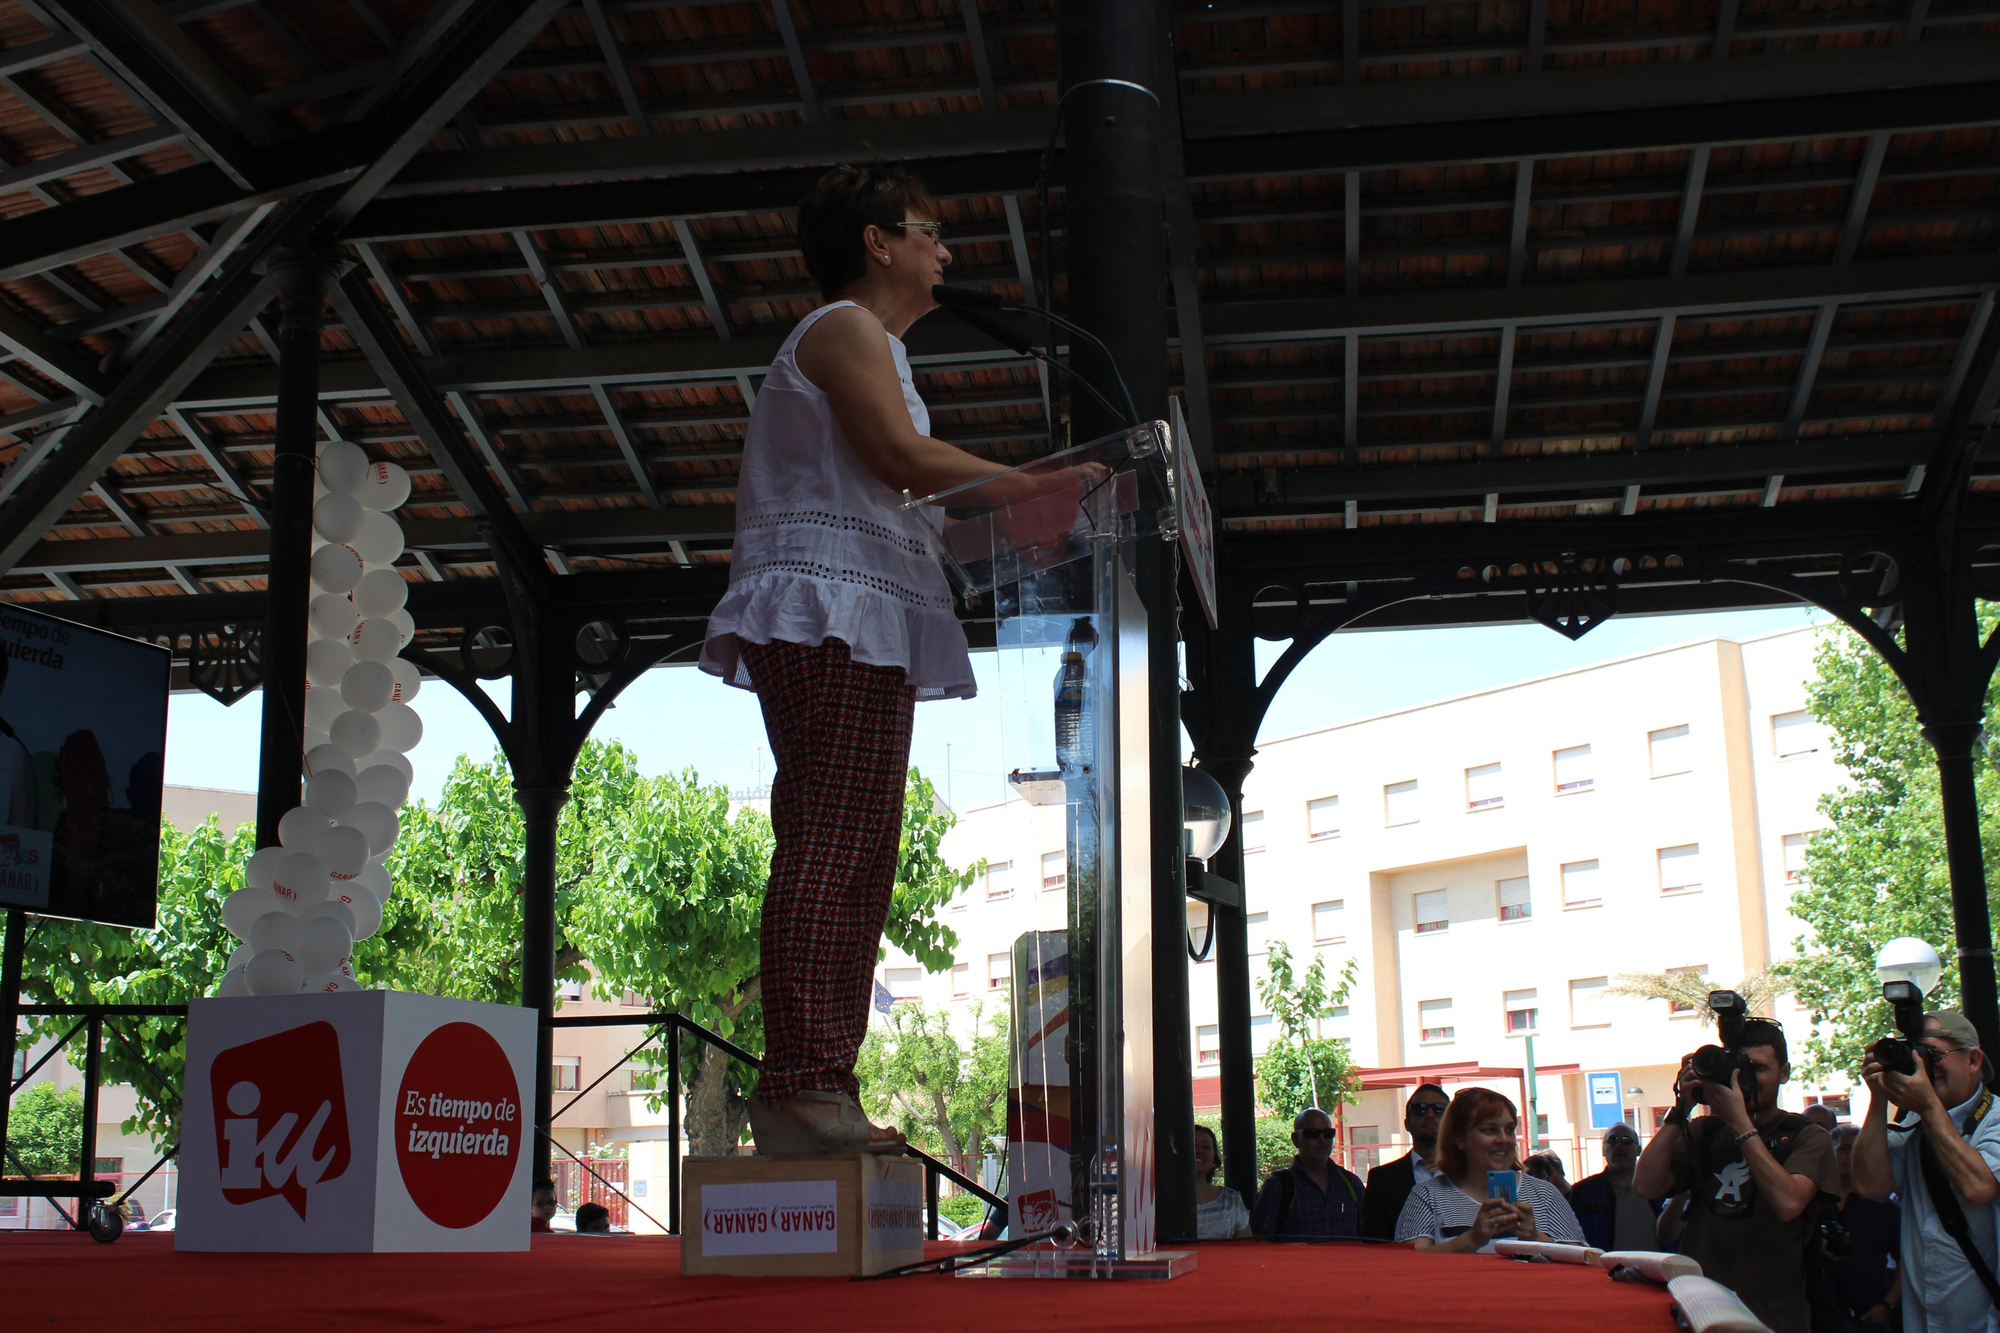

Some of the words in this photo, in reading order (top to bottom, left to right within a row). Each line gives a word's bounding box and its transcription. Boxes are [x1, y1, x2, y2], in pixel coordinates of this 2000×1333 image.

[51, 625, 70, 645] de
[0, 638, 64, 670] uierda
[391, 683, 402, 703] GANA
[0, 869, 32, 891] ANAR
[403, 1091, 426, 1116] Es
[429, 1093, 492, 1124] tiempo
[494, 1098, 516, 1122] de
[408, 1124, 509, 1159] izquierda
[714, 1212, 767, 1234] GANAR
[780, 1210, 835, 1232] GANAR
